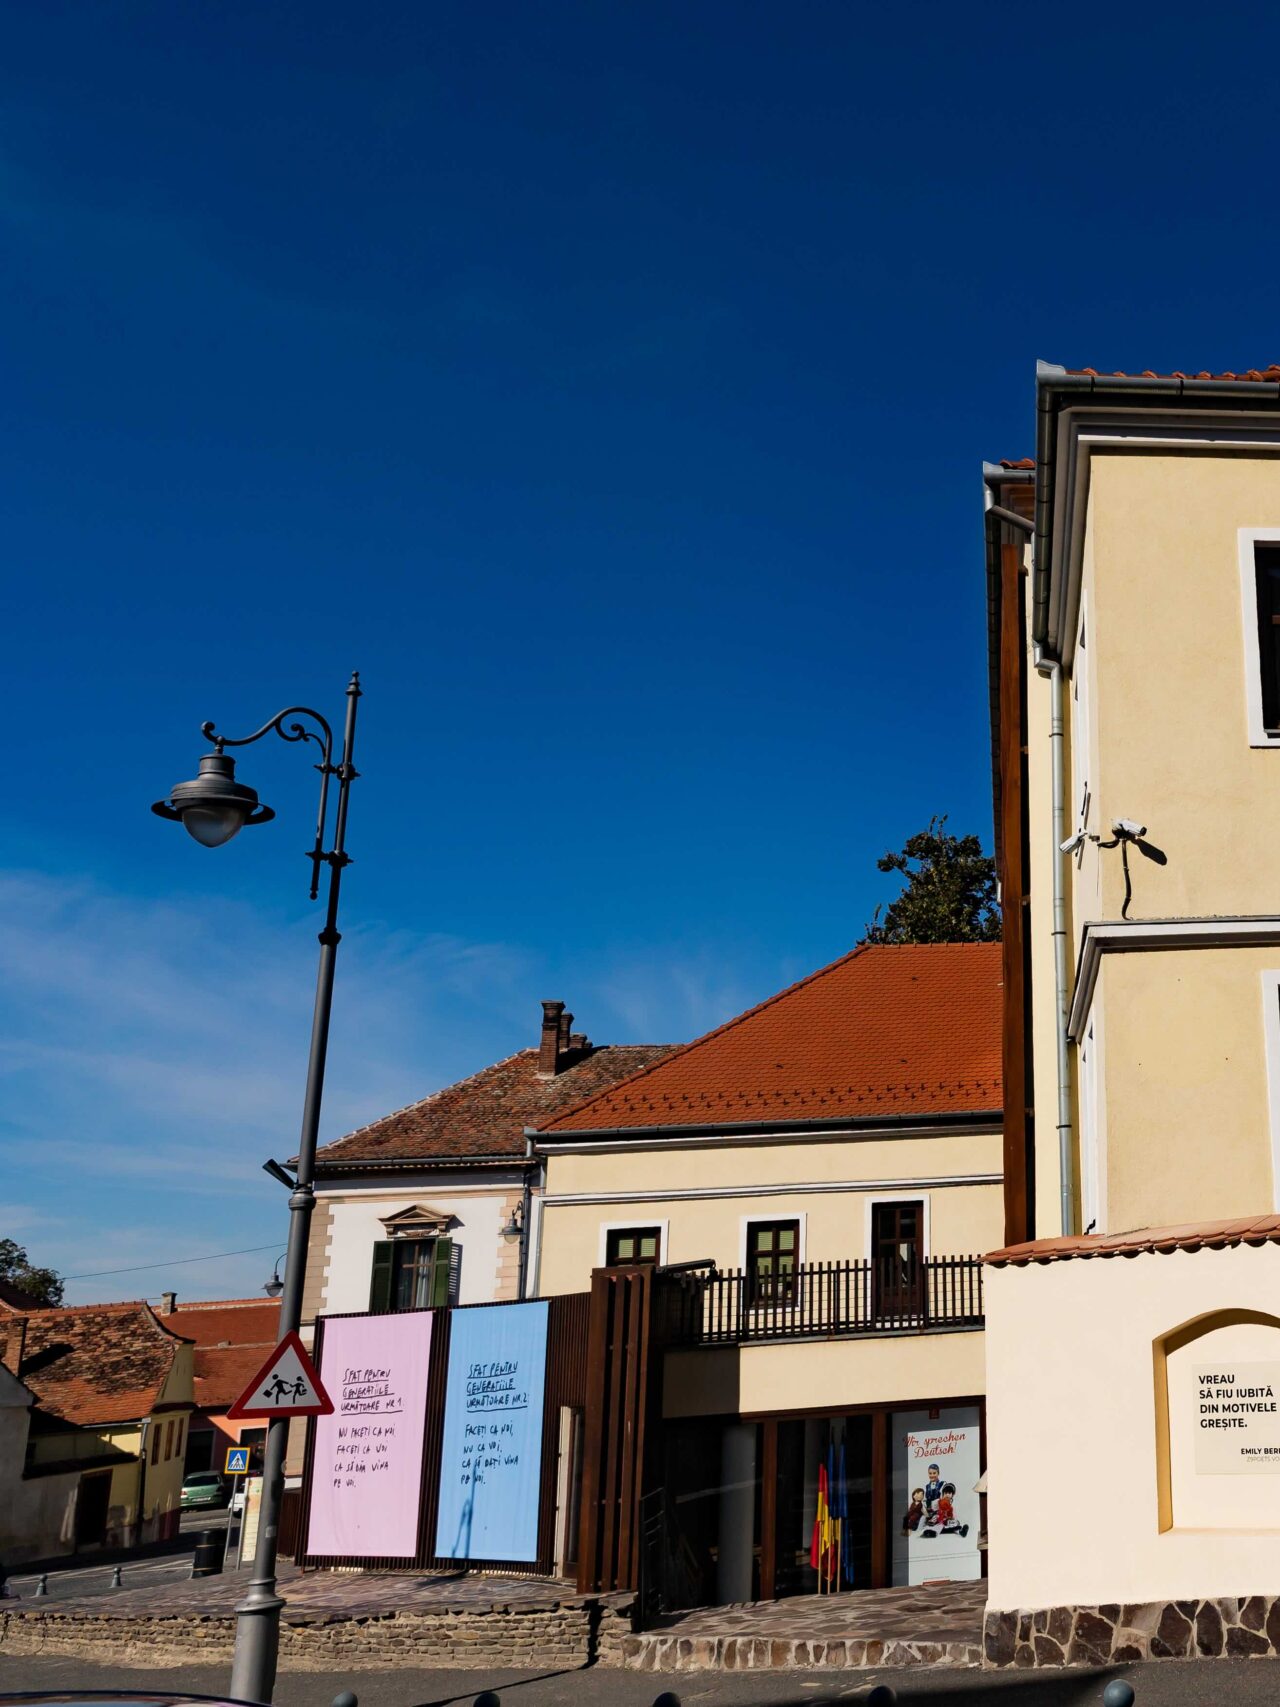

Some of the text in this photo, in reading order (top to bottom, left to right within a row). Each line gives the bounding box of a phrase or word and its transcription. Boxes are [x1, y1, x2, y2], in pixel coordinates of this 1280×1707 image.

[1199, 1375, 1235, 1384] VREAU
[1199, 1385, 1274, 1399] SĂ FIU IUBITĂ
[1200, 1402, 1277, 1414] DIN MOTIVELE
[1200, 1418, 1248, 1431] GREȘITE.
[338, 1427, 348, 1439] NU
[373, 1427, 382, 1437] CA
[490, 1425, 498, 1436] CA
[924, 1430, 966, 1448] sprechen
[363, 1445, 370, 1454] CA
[464, 1445, 473, 1454] NU
[478, 1443, 485, 1453] CA
[914, 1442, 957, 1458] Deutsch!
[1240, 1447, 1261, 1455] EMILY
[334, 1462, 343, 1472] CA
[462, 1458, 471, 1469] CA
